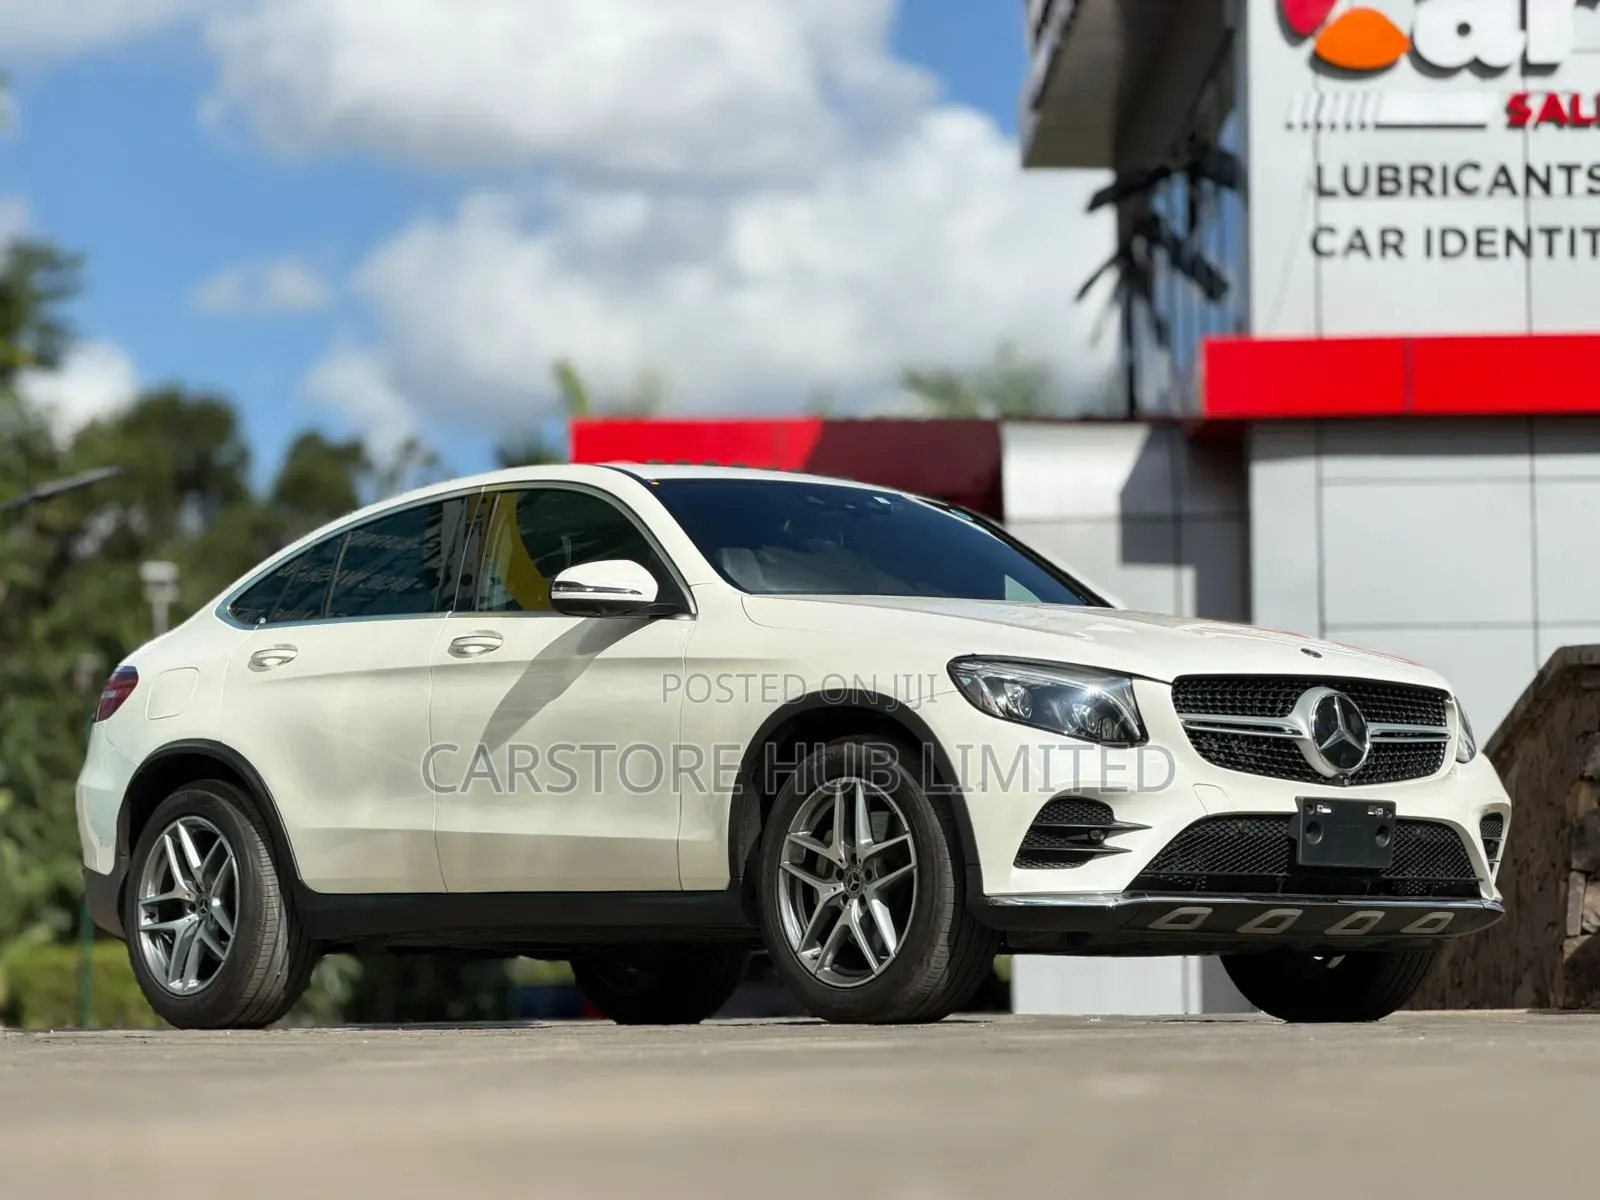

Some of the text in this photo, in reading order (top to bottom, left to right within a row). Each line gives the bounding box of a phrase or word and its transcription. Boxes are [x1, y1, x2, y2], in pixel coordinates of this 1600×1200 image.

[1506, 92, 1600, 128] SAL
[1316, 163, 1600, 198] LUBRICANTS
[1311, 226, 1600, 259] CAR IDENTIT
